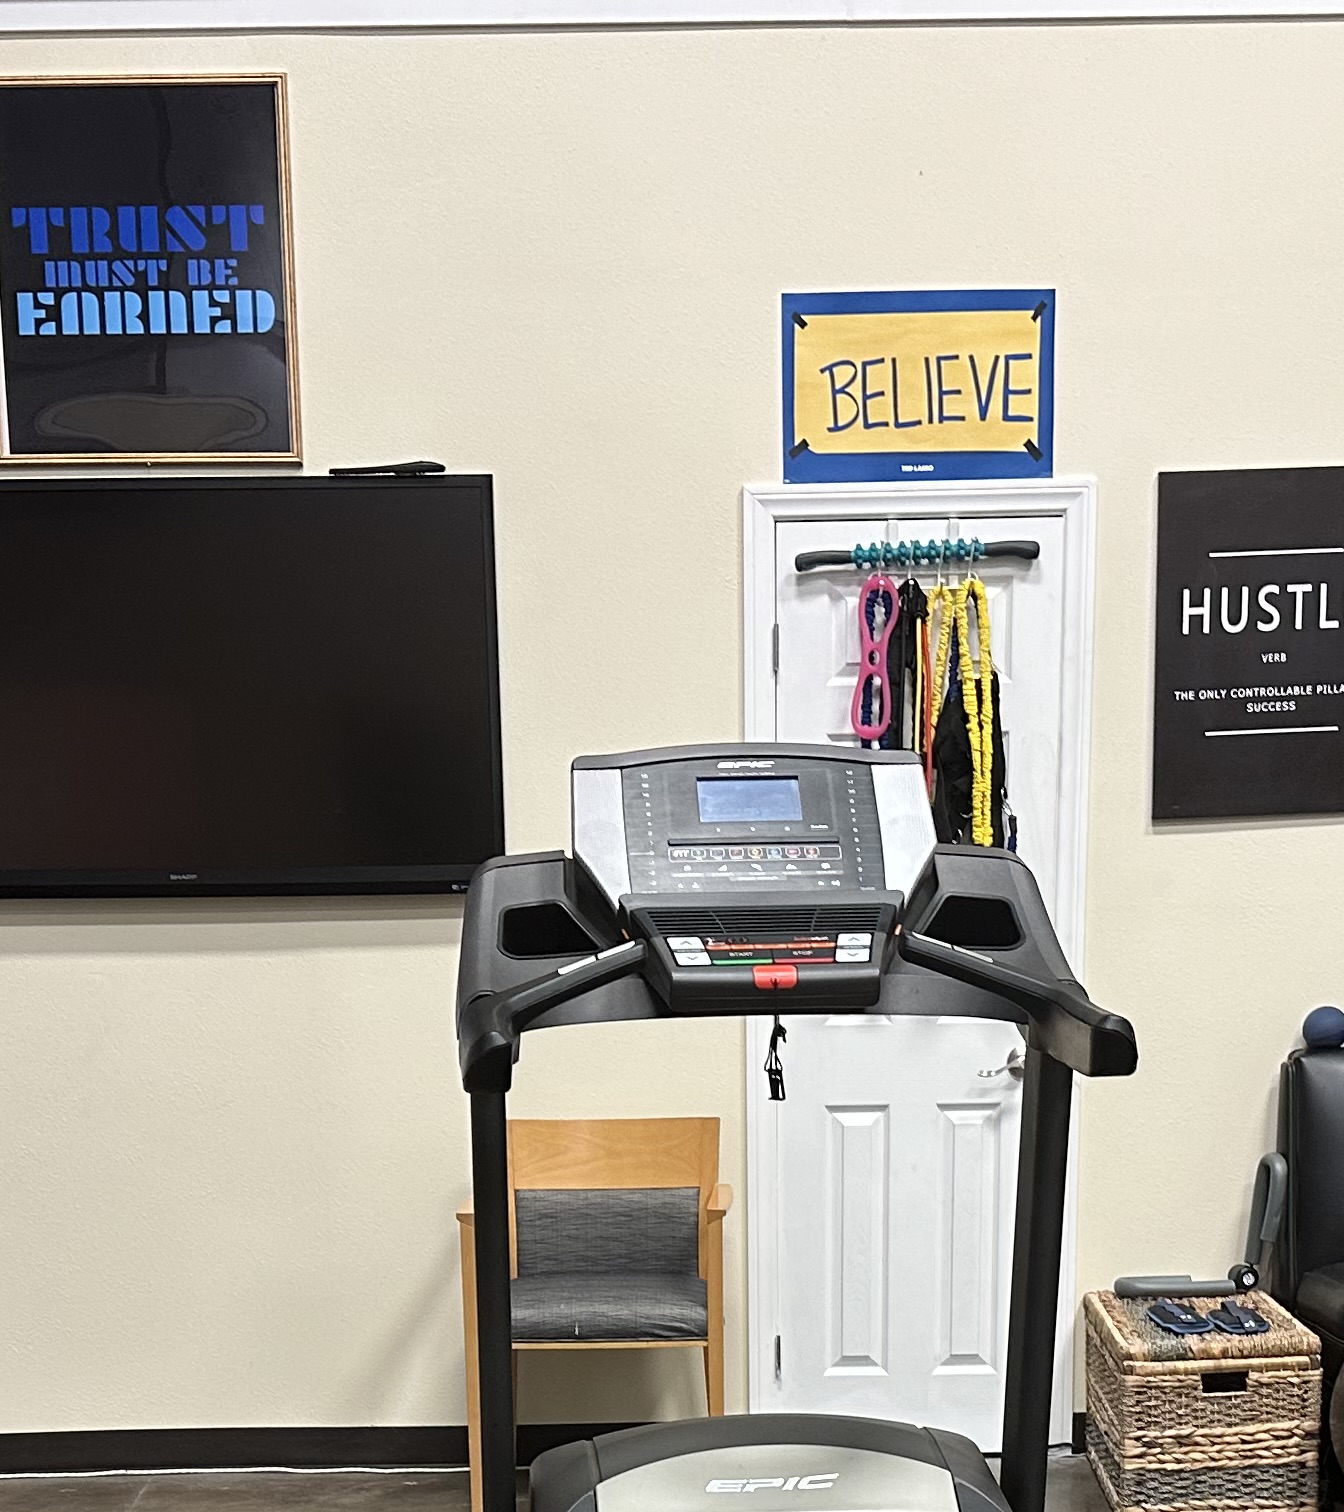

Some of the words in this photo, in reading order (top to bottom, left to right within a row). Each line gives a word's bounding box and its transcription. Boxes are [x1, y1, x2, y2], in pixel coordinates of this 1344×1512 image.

[11, 204, 264, 254] TRUST
[44, 260, 167, 287] MUST
[187, 259, 238, 285] BE
[16, 290, 276, 336] EARNED
[819, 353, 1034, 433] BELIEVE
[1261, 652, 1287, 664] VERB
[1174, 690, 1196, 701] THE
[1198, 689, 1227, 700] ONLY
[1230, 685, 1313, 698] CONTROLLABLE
[1246, 701, 1297, 713] SUCCESS
[705, 1472, 840, 1493] EPIC
